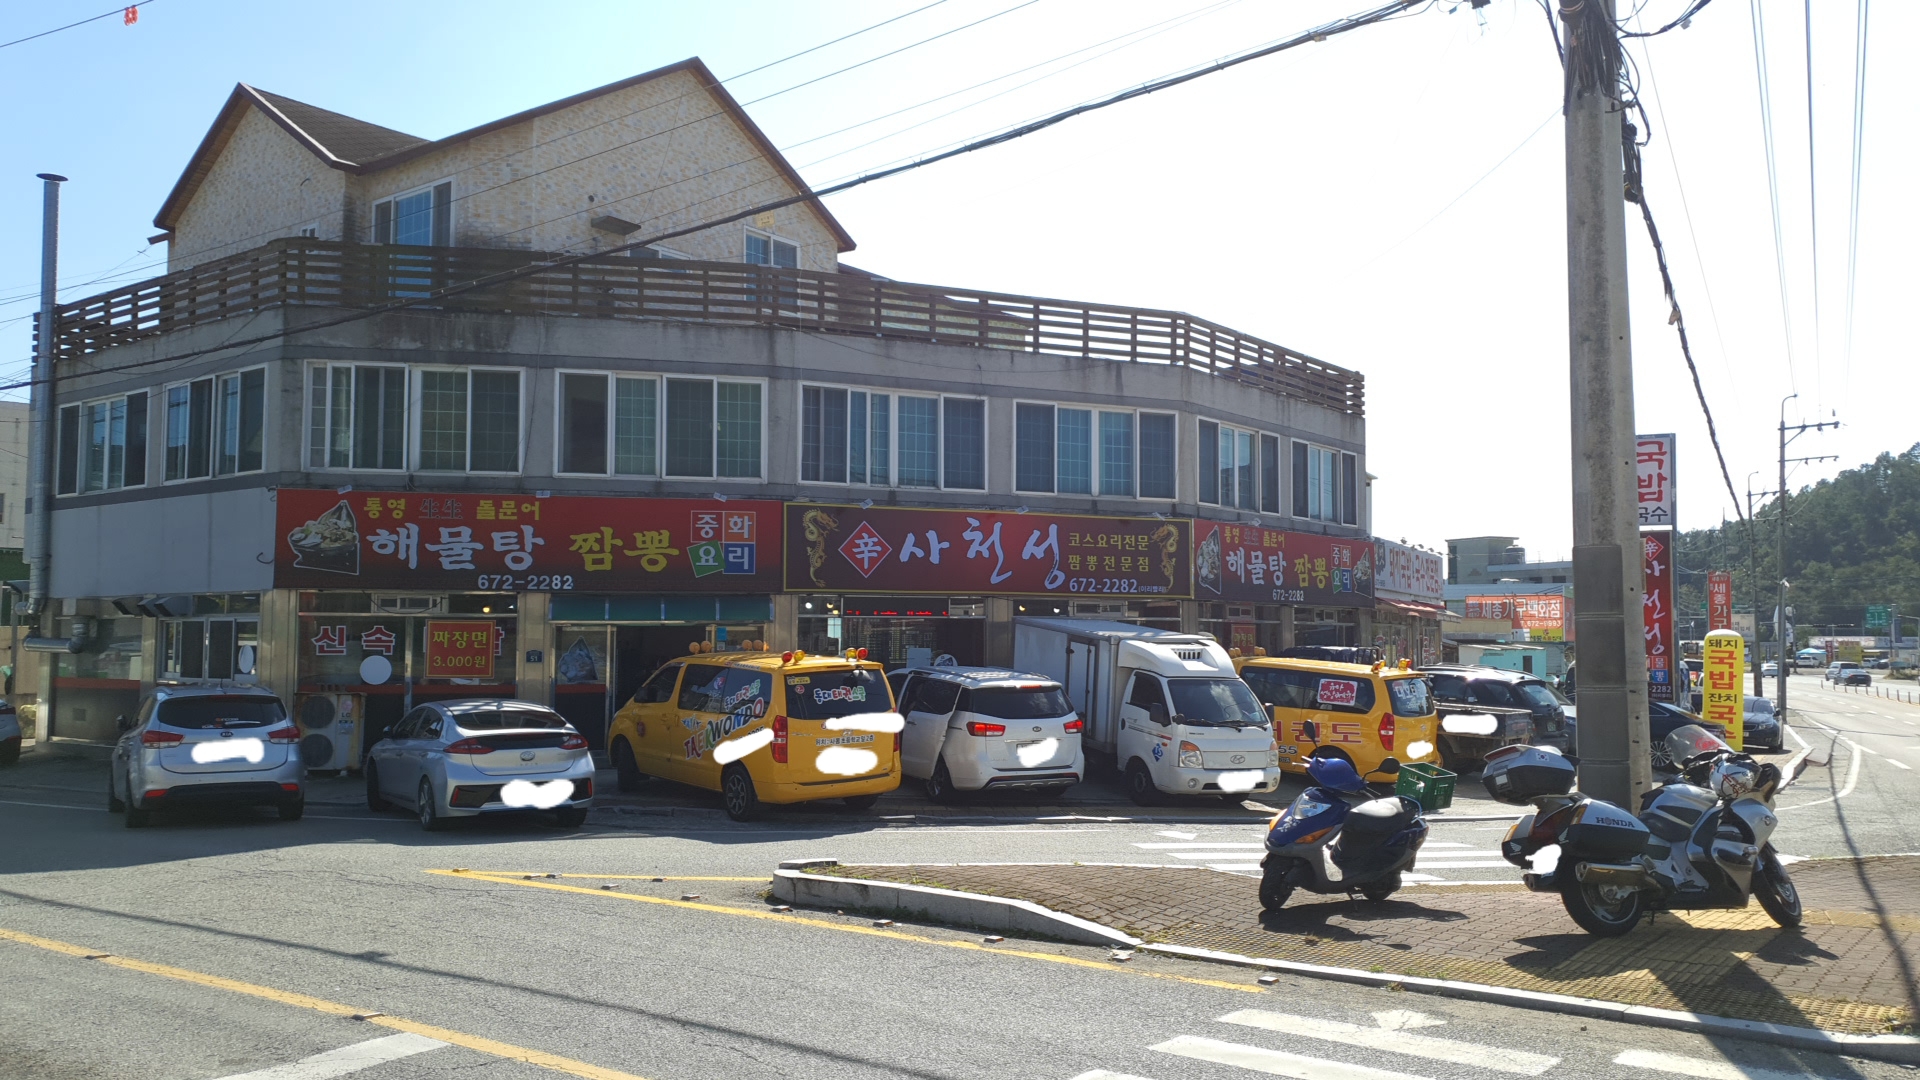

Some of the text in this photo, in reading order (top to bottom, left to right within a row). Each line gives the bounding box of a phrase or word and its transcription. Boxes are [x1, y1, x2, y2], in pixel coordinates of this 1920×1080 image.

[363, 497, 541, 521] 통영 生生 돌문어
[694, 513, 754, 540] 중화
[1224, 526, 1240, 543] 통영
[366, 522, 680, 573] 해물탕 짬뽕
[1068, 531, 1150, 550] 코스요리전문
[695, 542, 753, 573] 요리
[852, 532, 883, 570] 辛
[899, 516, 1066, 590] 사천성
[1332, 548, 1351, 565] 중화
[1068, 554, 1150, 573] 짬뽕전문점
[1225, 546, 1329, 589] 해물탕 짬뽕
[476, 574, 574, 590] 672-2282
[1069, 577, 1138, 593] 672-2282
[1332, 570, 1351, 590] 요리
[1272, 589, 1304, 601] 672-2282
[1481, 598, 1561, 619] 세종가구백화점
[312, 625, 396, 656] 신속
[433, 631, 488, 649] 짜장면
[1708, 639, 1738, 650] 돼지
[433, 656, 487, 668] 3.000원
[529, 655, 539, 663] 51
[1708, 650, 1737, 690] 국밥
[813, 686, 866, 705] 동대태권스쿨
[1708, 693, 1738, 703] 잔치
[683, 697, 764, 760] TAEKWONDO
